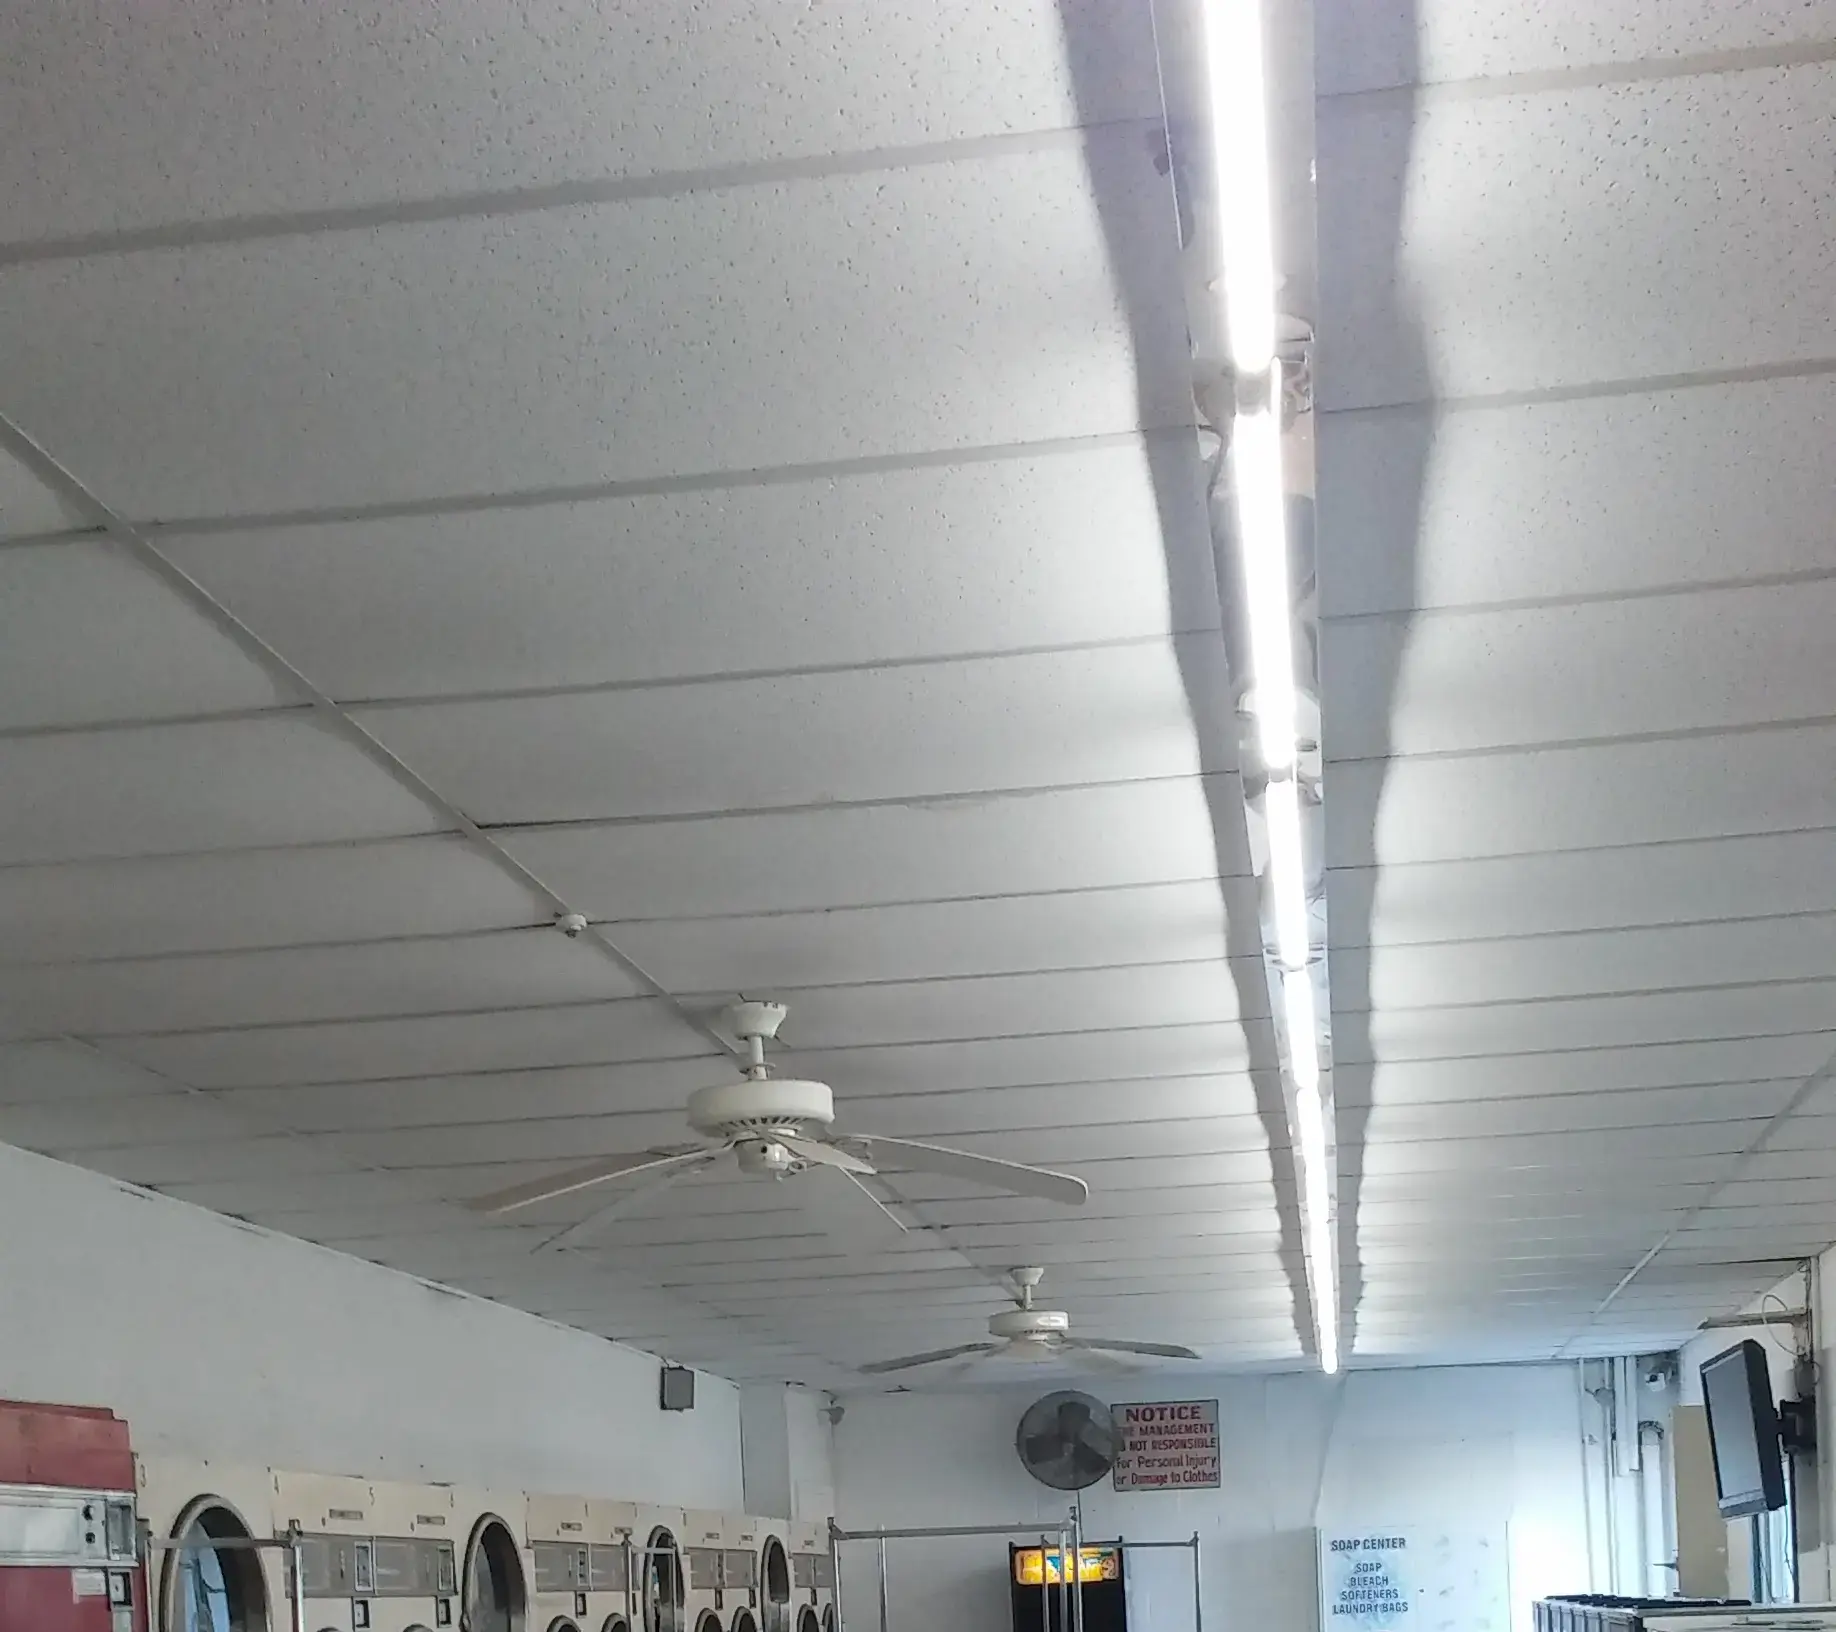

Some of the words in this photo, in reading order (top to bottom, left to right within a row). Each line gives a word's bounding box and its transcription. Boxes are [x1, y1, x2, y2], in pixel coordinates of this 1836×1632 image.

[1125, 1405, 1201, 1422] NOTICE
[1139, 1423, 1214, 1436] MANAGEMENT
[1129, 1441, 1147, 1451] NOT
[1151, 1438, 1216, 1450] RESPONSIBLE
[1138, 1454, 1183, 1468] Personal
[1185, 1453, 1216, 1469] Injury
[1131, 1473, 1168, 1486] Damage
[1171, 1472, 1181, 1483] to
[1183, 1470, 1218, 1482] Clothes
[1331, 1540, 1360, 1551] SOAP
[1363, 1538, 1406, 1550] CENTER
[1356, 1563, 1382, 1573] SOAP
[1350, 1576, 1389, 1587] BLEACH
[1341, 1589, 1399, 1600] SOFTENERS
[1333, 1604, 1378, 1615] LAUNDRY
[1381, 1602, 1409, 1613] BAGS
